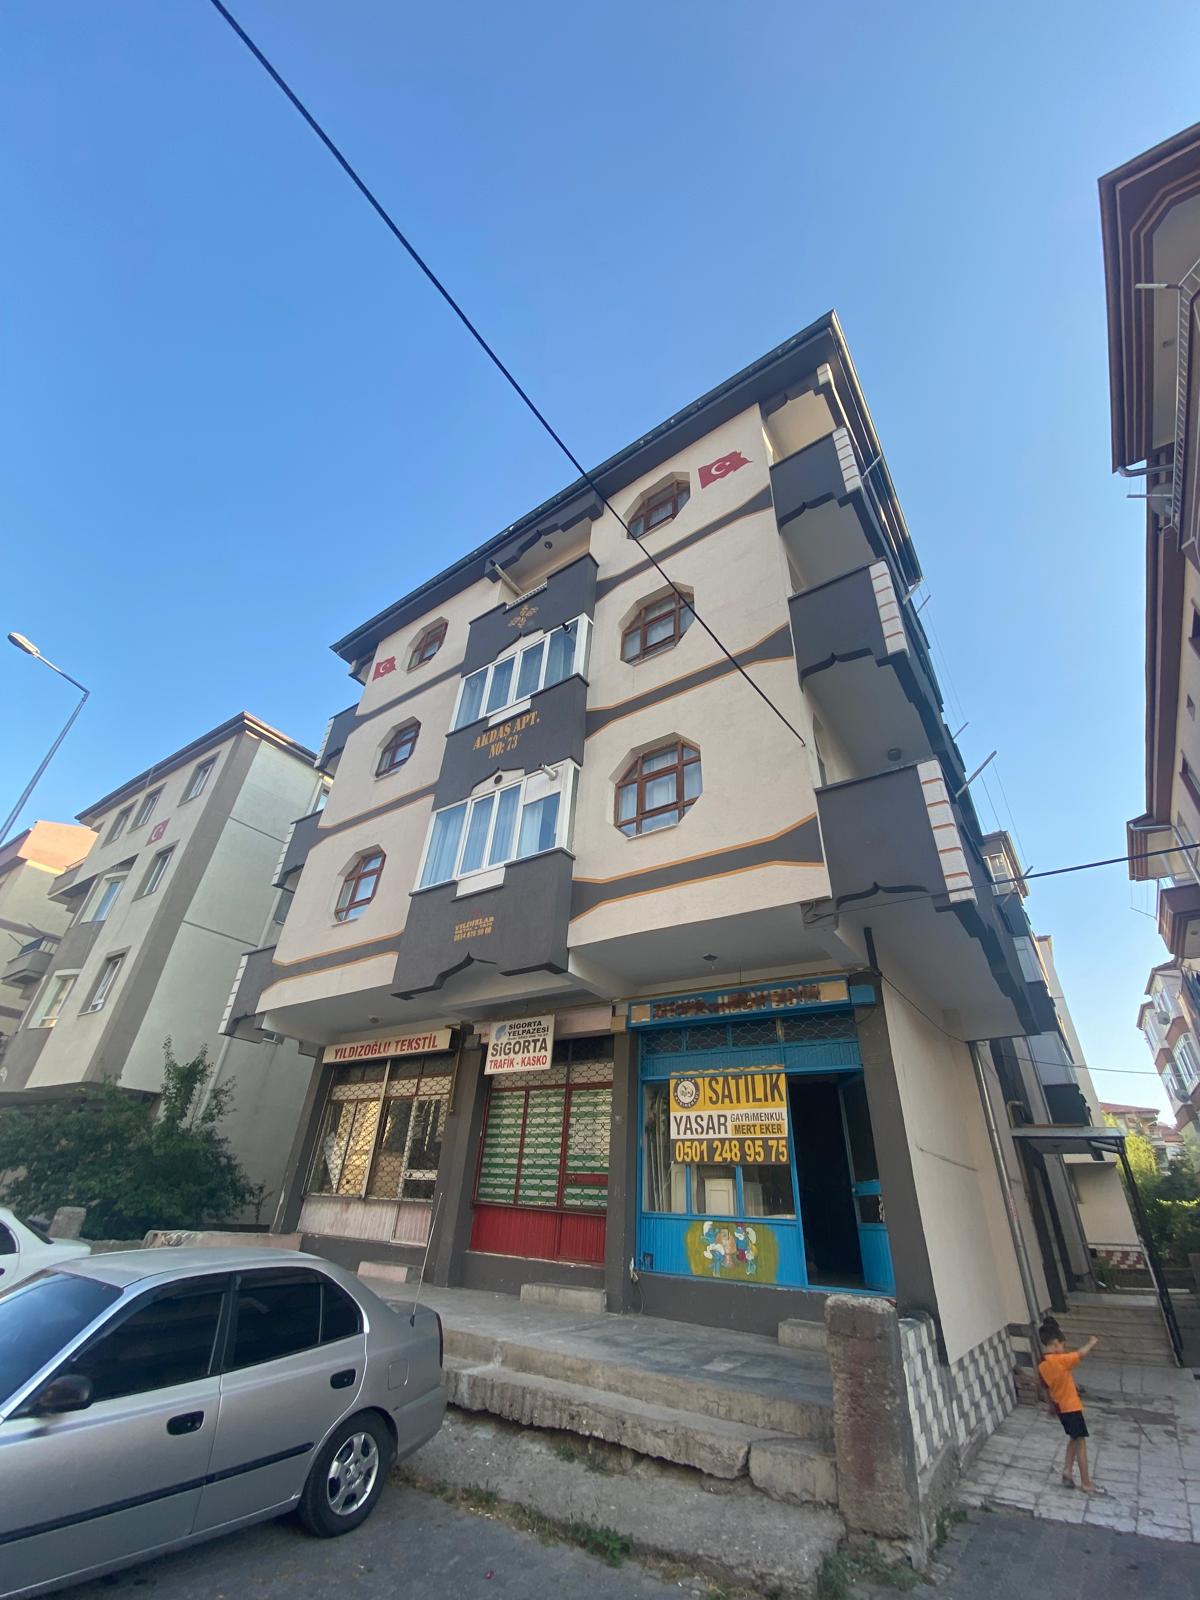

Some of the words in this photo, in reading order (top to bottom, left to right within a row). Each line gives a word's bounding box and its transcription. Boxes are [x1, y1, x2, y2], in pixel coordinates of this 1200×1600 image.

[334, 1041, 391, 1059] YILDIZOĞLU
[394, 1033, 438, 1052] TEKSTİL
[521, 1055, 548, 1067] KASKO
[708, 1073, 785, 1105] SATILIK
[734, 1124, 757, 1134] MERT
[759, 1123, 783, 1134] EKER
[675, 1140, 708, 1162] 0501
[713, 1140, 740, 1162] 248
[745, 1140, 764, 1161] 95
[768, 1139, 788, 1161] 75
